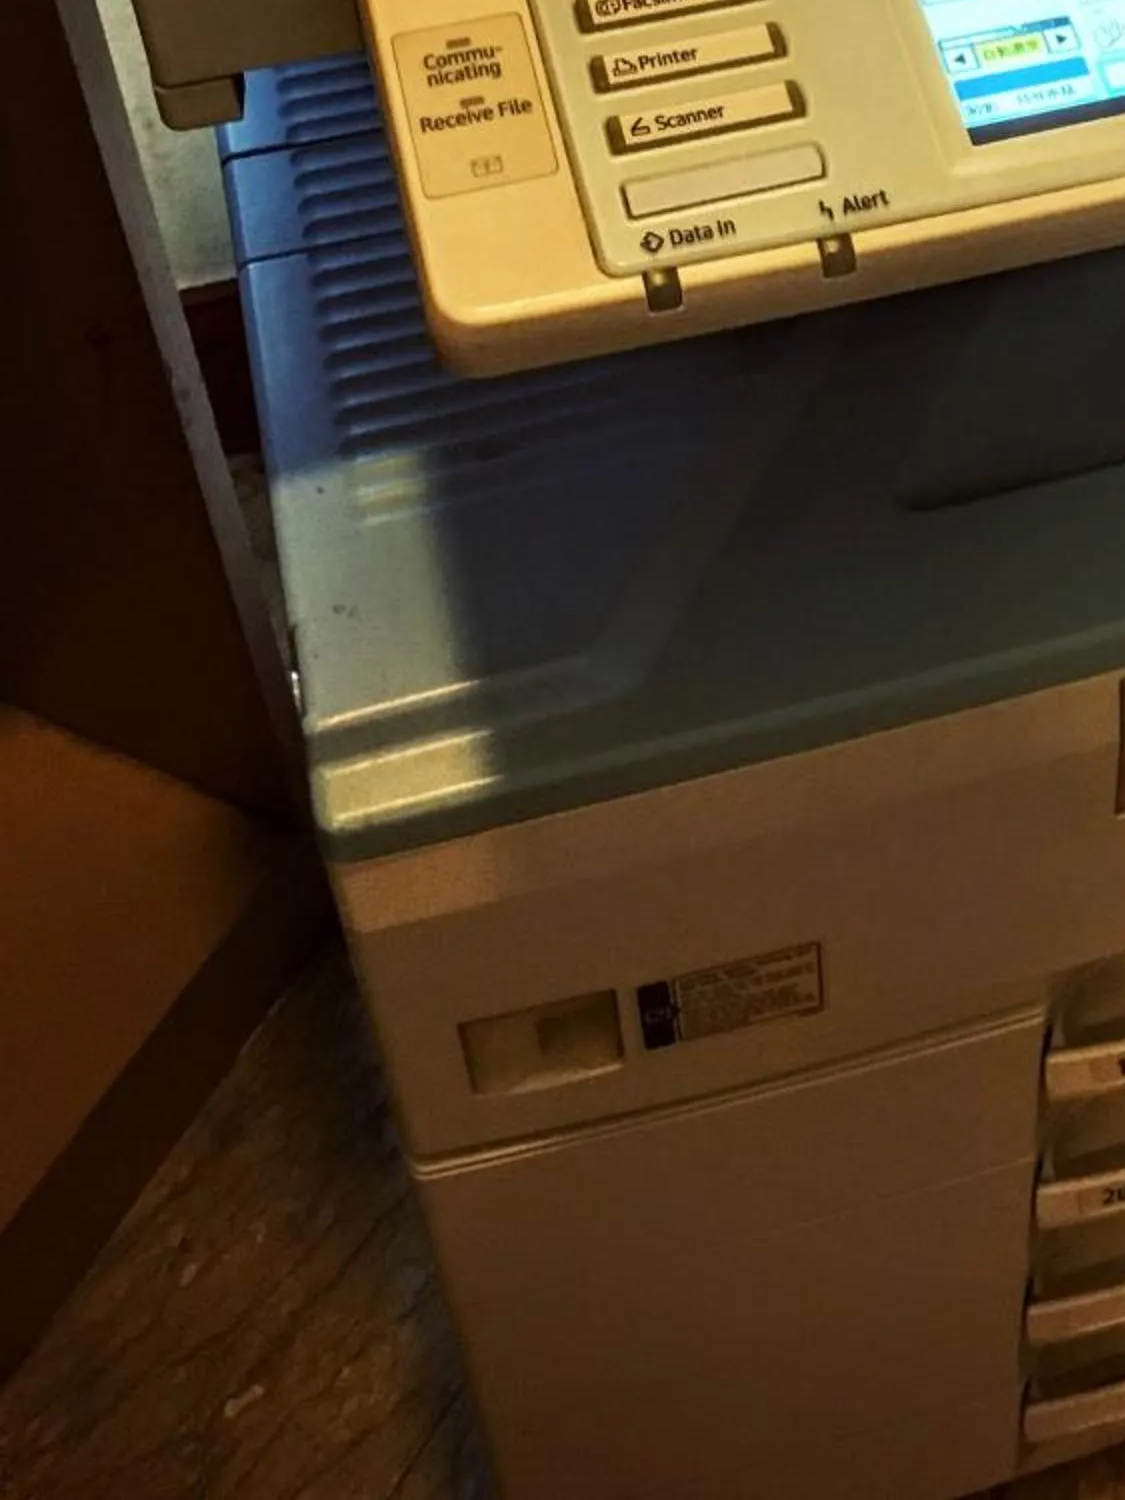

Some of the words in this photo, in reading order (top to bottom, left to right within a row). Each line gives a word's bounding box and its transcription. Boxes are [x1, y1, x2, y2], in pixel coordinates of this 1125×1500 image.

[423, 45, 504, 71] Commu-
[637, 48, 698, 71] Printer
[426, 61, 502, 88] nicating
[419, 105, 495, 135] Receive
[497, 98, 534, 118] File
[654, 105, 725, 132] Scanner
[841, 189, 890, 217] Alert
[668, 223, 715, 246] Data
[716, 218, 737, 236] In
